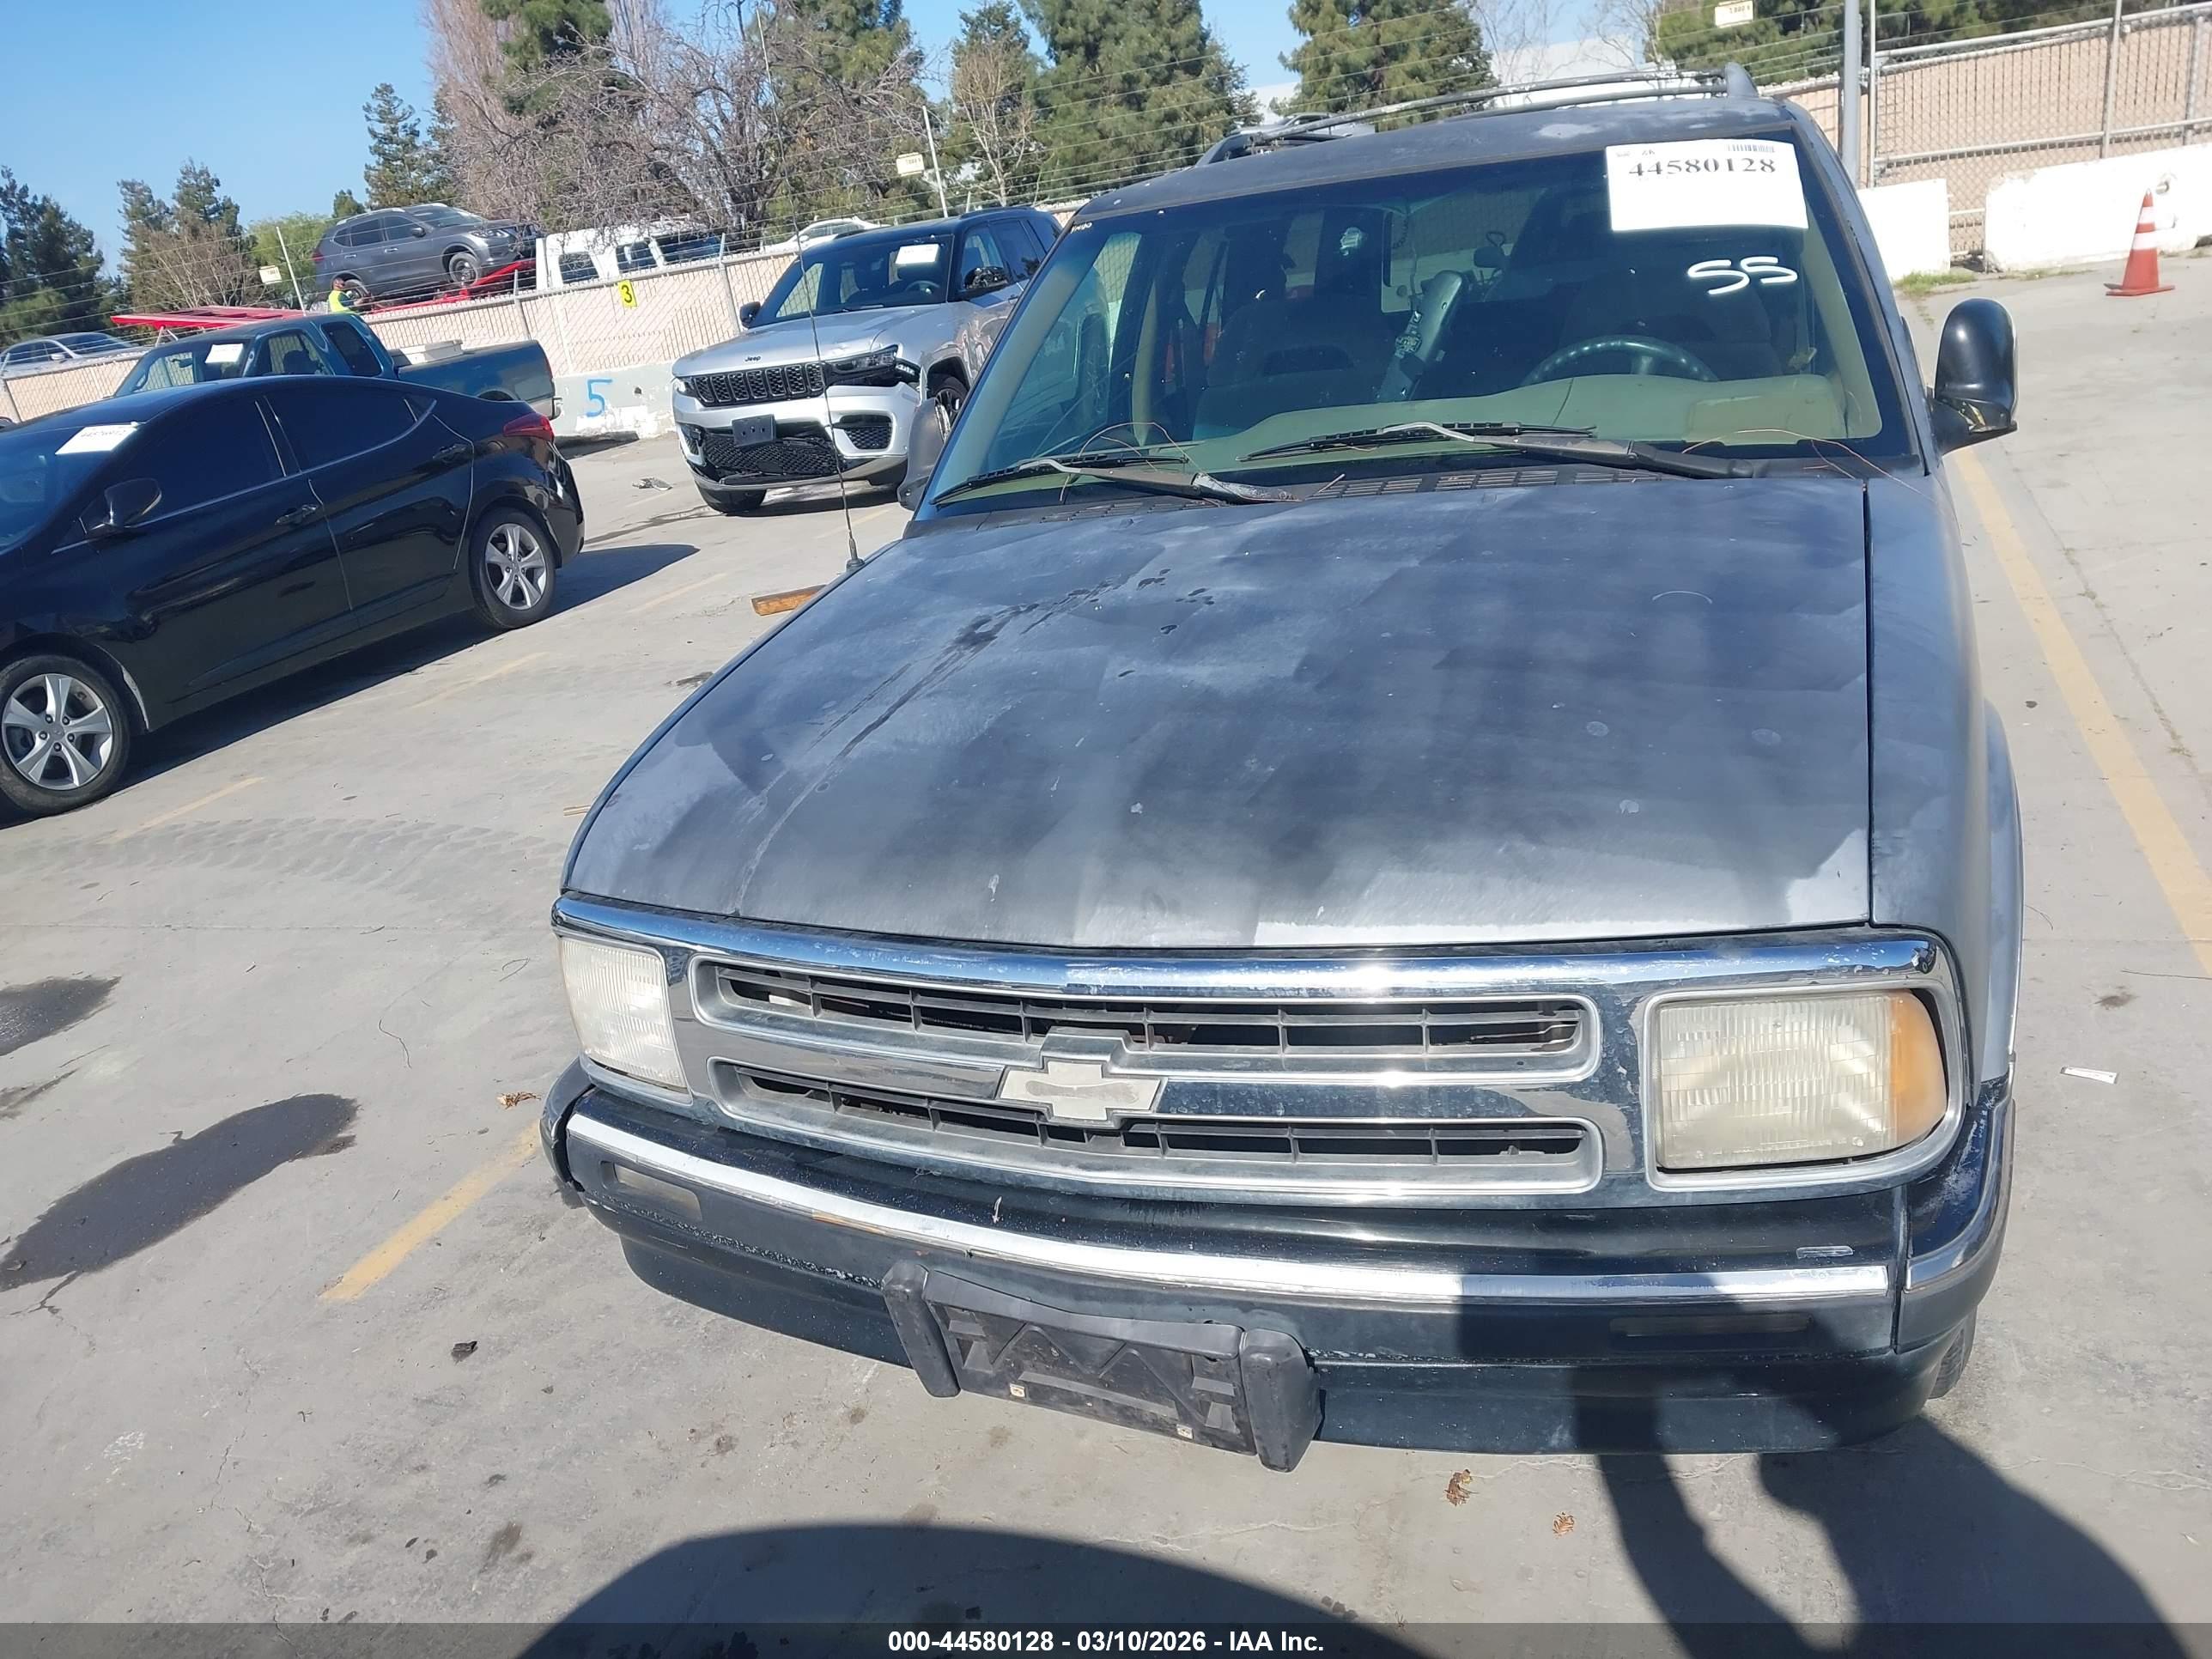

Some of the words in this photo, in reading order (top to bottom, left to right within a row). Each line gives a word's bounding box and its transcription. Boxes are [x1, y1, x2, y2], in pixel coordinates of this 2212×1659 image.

[1628, 157, 1777, 177] 44580128
[620, 284, 633, 304] 3
[585, 378, 614, 418] 5
